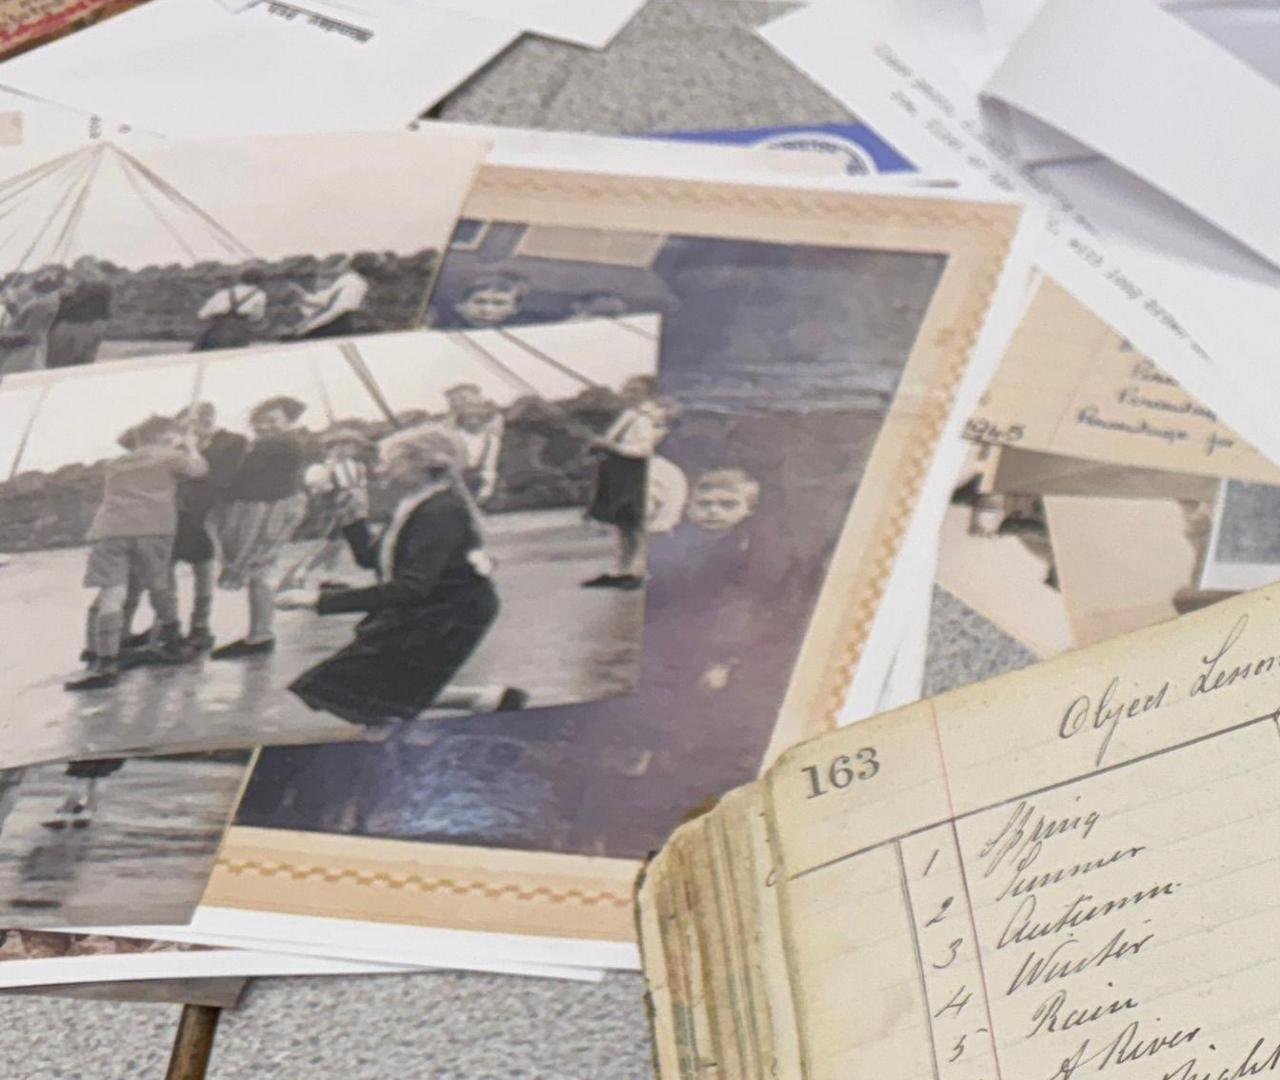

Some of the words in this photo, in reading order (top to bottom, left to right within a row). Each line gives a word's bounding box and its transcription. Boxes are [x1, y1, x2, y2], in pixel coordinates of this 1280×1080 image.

[1059, 677, 1169, 768] Object
[800, 746, 882, 800] 163
[923, 848, 940, 877] 1
[924, 896, 956, 928] 2
[995, 841, 1147, 903] Summer
[933, 938, 964, 970] 3
[933, 984, 974, 1019] 4
[1005, 932, 1156, 997] Winter
[948, 1027, 989, 1063] 5
[1025, 982, 1140, 1039] Rain
[1098, 1017, 1203, 1073] River
